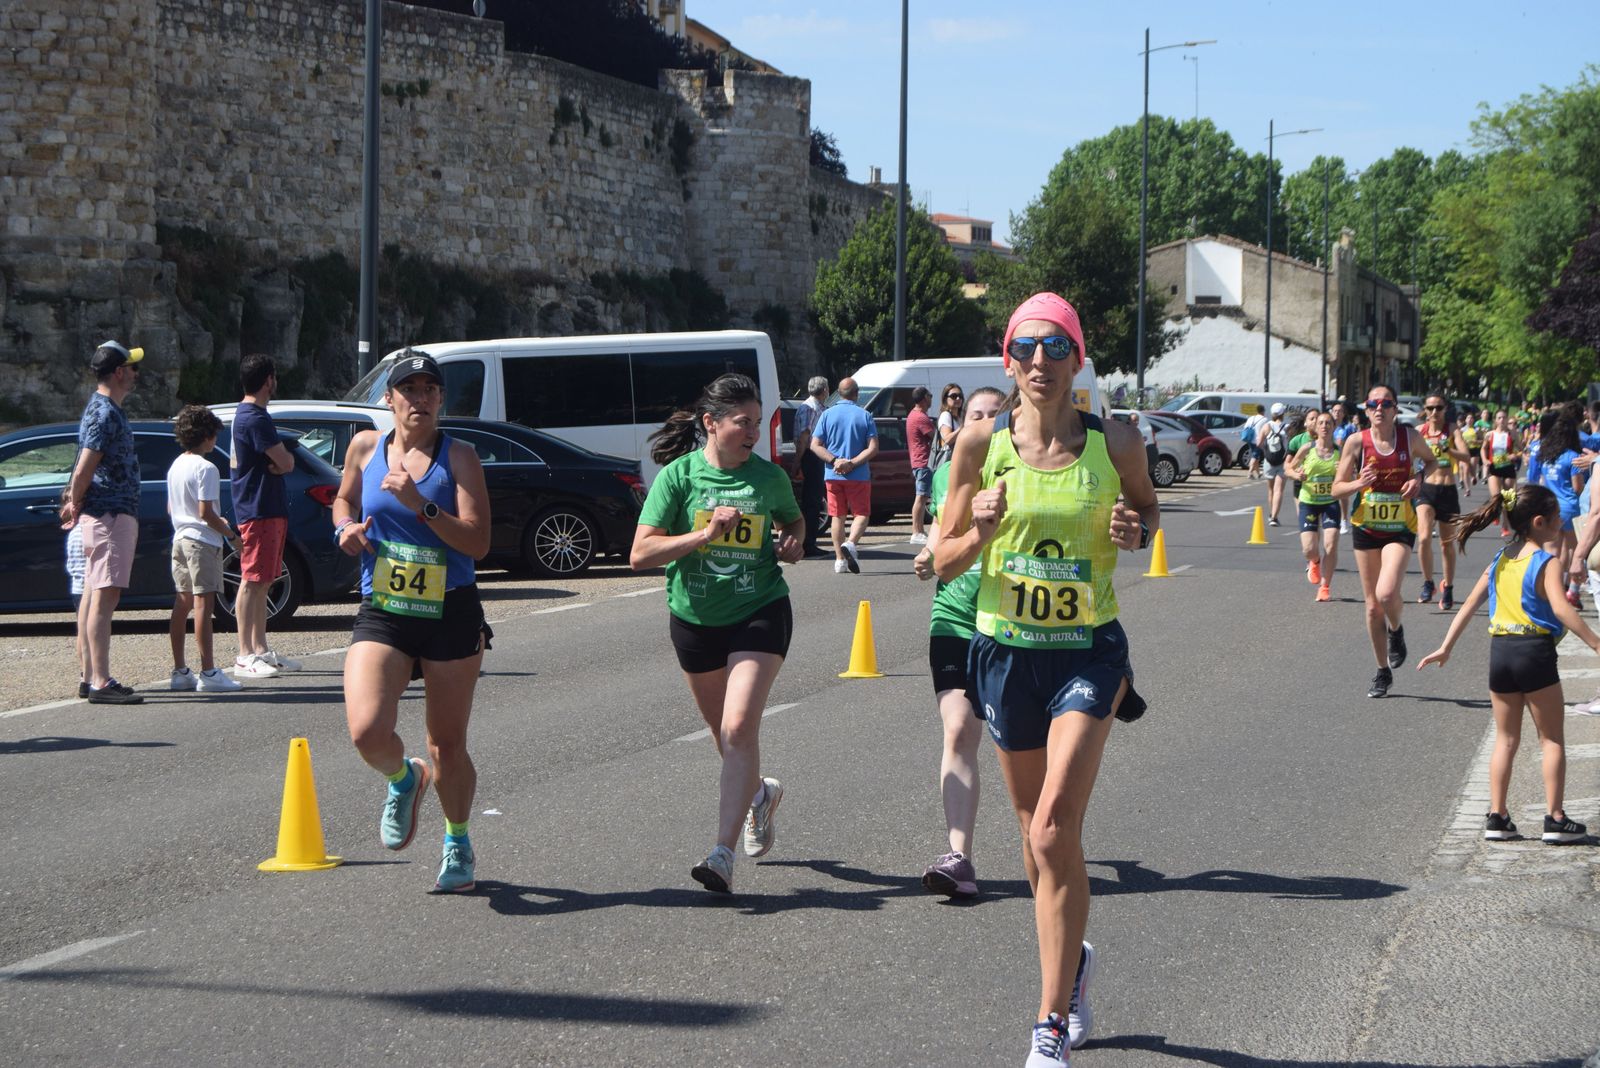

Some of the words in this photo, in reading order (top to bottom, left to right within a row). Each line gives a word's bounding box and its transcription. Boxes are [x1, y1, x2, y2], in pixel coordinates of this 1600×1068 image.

[1369, 504, 1400, 520] 107
[710, 549, 729, 558] CAJA
[731, 551, 756, 560] RURAL
[389, 565, 427, 595] 54
[1028, 569, 1047, 579] CAJA
[1050, 571, 1080, 580] RURAL
[390, 600, 409, 610] CAJA
[411, 603, 438, 613] RURAL
[1011, 581, 1079, 621] 103
[1021, 631, 1047, 642] CAJA
[1050, 632, 1087, 642] RURAL
